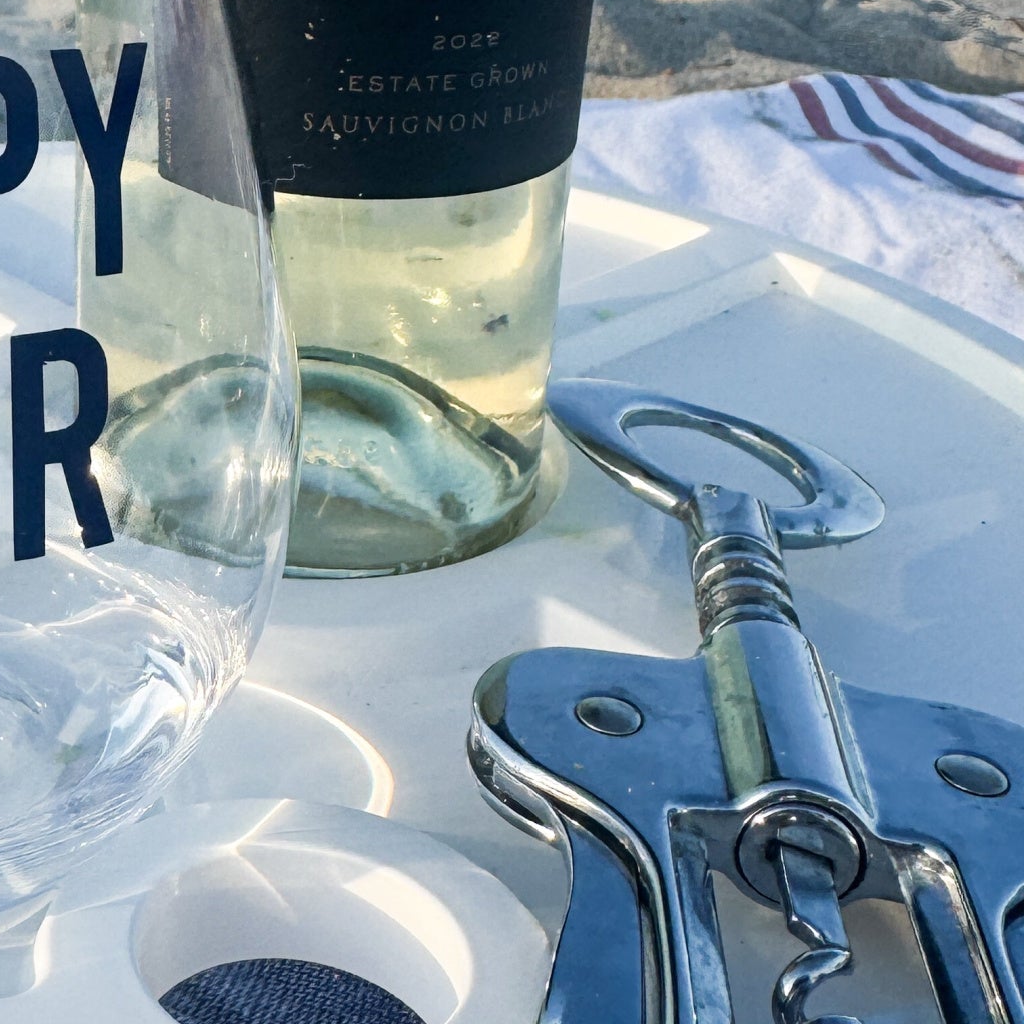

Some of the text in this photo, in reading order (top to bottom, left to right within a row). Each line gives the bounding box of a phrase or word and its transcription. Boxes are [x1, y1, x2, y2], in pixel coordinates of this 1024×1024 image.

[432, 31, 501, 51] 2022
[348, 60, 549, 93] ESTATE GROWN
[302, 112, 488, 135] SAUVIGNON
